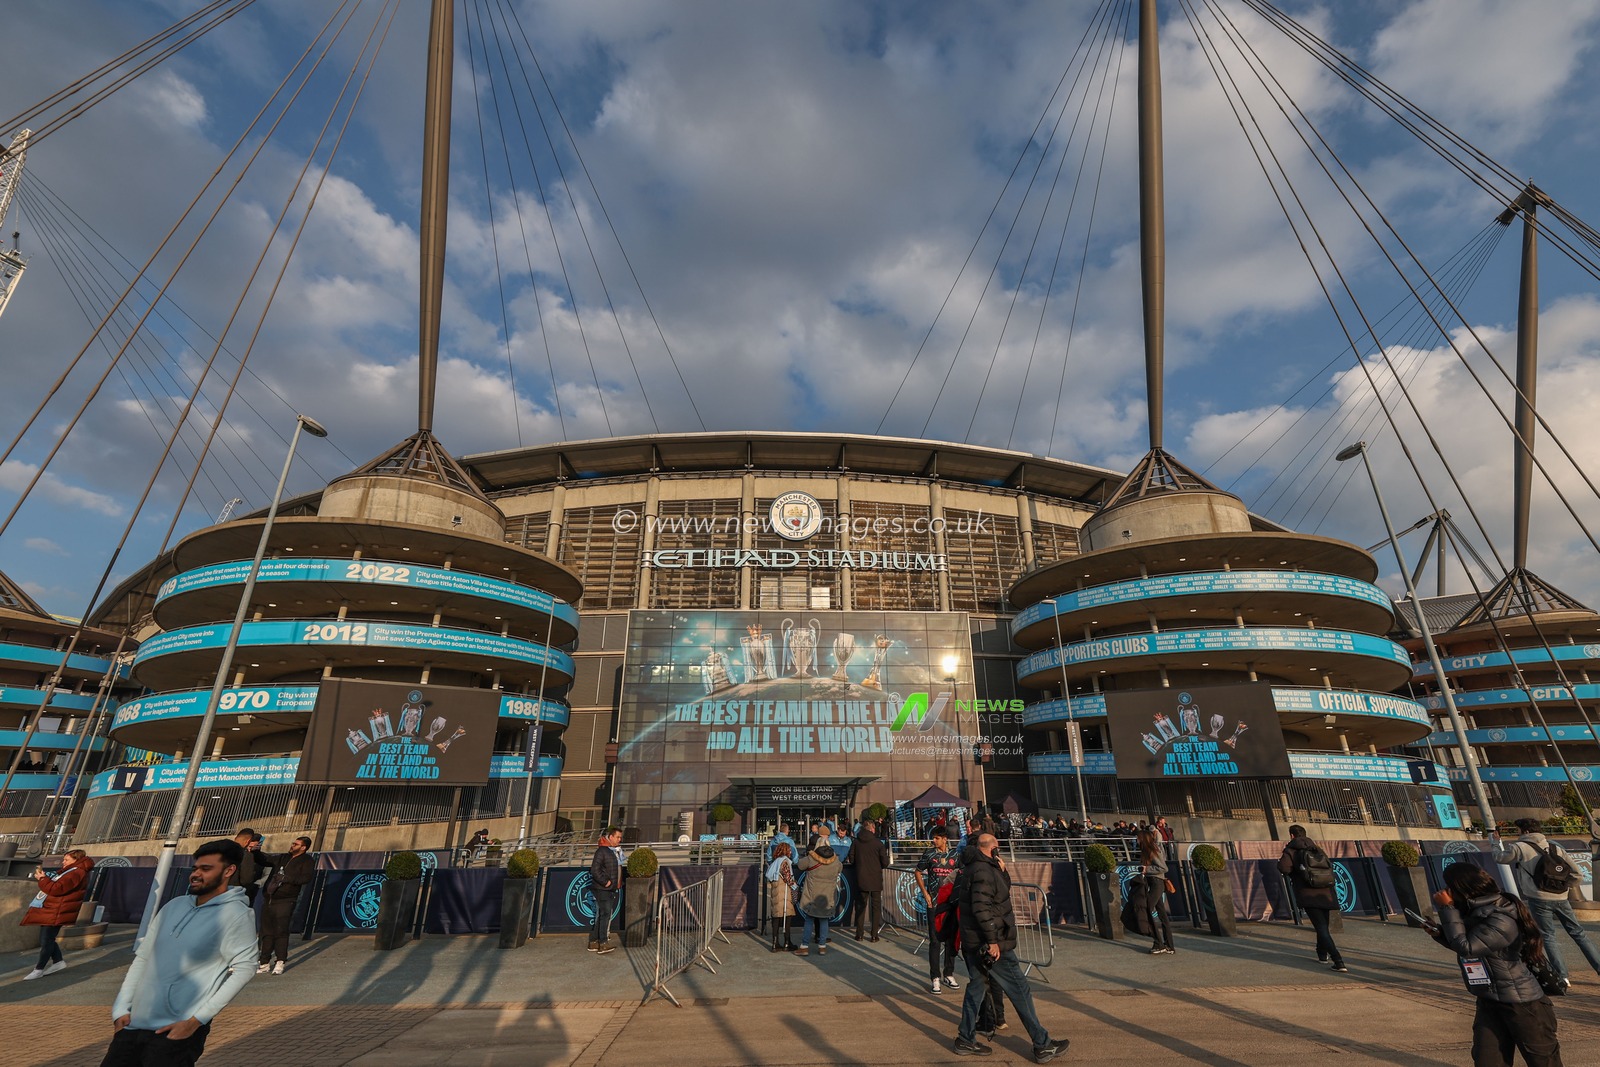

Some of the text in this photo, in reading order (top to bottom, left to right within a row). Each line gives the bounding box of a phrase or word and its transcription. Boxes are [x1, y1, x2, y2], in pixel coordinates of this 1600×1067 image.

[775, 495, 817, 510] MANCHESTER
[653, 549, 937, 570] ETIHAD STADIUM
[345, 563, 410, 582] 2022
[416, 571, 430, 580] City
[431, 572, 451, 581] defeat
[452, 575, 470, 584] Aston
[489, 583, 506, 591] secure
[416, 578, 439, 588] League
[453, 582, 480, 593] following
[480, 588, 500, 596] another
[178, 632, 188, 641] City
[303, 625, 367, 641] 2012
[375, 627, 390, 637] City
[416, 631, 442, 640] Premier
[443, 633, 465, 643] League
[185, 639, 202, 647] known
[405, 636, 426, 646] Sergio
[427, 638, 450, 648] Agüero
[1030, 653, 1054, 672] OFFICIAL
[1054, 641, 1110, 665] SUPPORTERS
[1113, 637, 1149, 655] CLUBS
[1452, 655, 1487, 668] CITY
[278, 692, 293, 700] City
[1532, 686, 1577, 699] CITY
[144, 702, 154, 710] City
[162, 699, 175, 707] their
[175, 696, 197, 705] second
[219, 690, 270, 710] 970
[276, 699, 313, 707] European
[1319, 692, 1370, 712] OFFICIAL
[1370, 696, 1418, 721] SUPPORTERS
[115, 702, 142, 725] 1968
[152, 708, 169, 717] league
[675, 705, 698, 721] THE
[700, 700, 752, 725] BEST
[753, 700, 811, 724] TEAM
[813, 700, 833, 724] IN
[834, 701, 873, 724] THE
[401, 736, 412, 744] THE
[706, 727, 894, 754] AND ALL THE WORLD
[379, 743, 429, 755] BEST TEAM
[1173, 742, 1219, 753] BEST TEAM
[366, 754, 436, 765] IN THE LAND AND
[1166, 753, 1177, 763] IN
[1177, 753, 1192, 763] THE
[1193, 752, 1216, 762] LAND
[219, 765, 259, 774] Wanderers
[356, 765, 440, 779] ALL THE WORLD
[1163, 763, 1239, 775] ALL THE WORLD
[1418, 766, 1427, 779] T
[1447, 769, 1469, 780] ITY
[124, 773, 137, 788] V
[159, 775, 185, 784] becomin
[218, 773, 265, 781] Manchester
[361, 917, 377, 928] CITY
